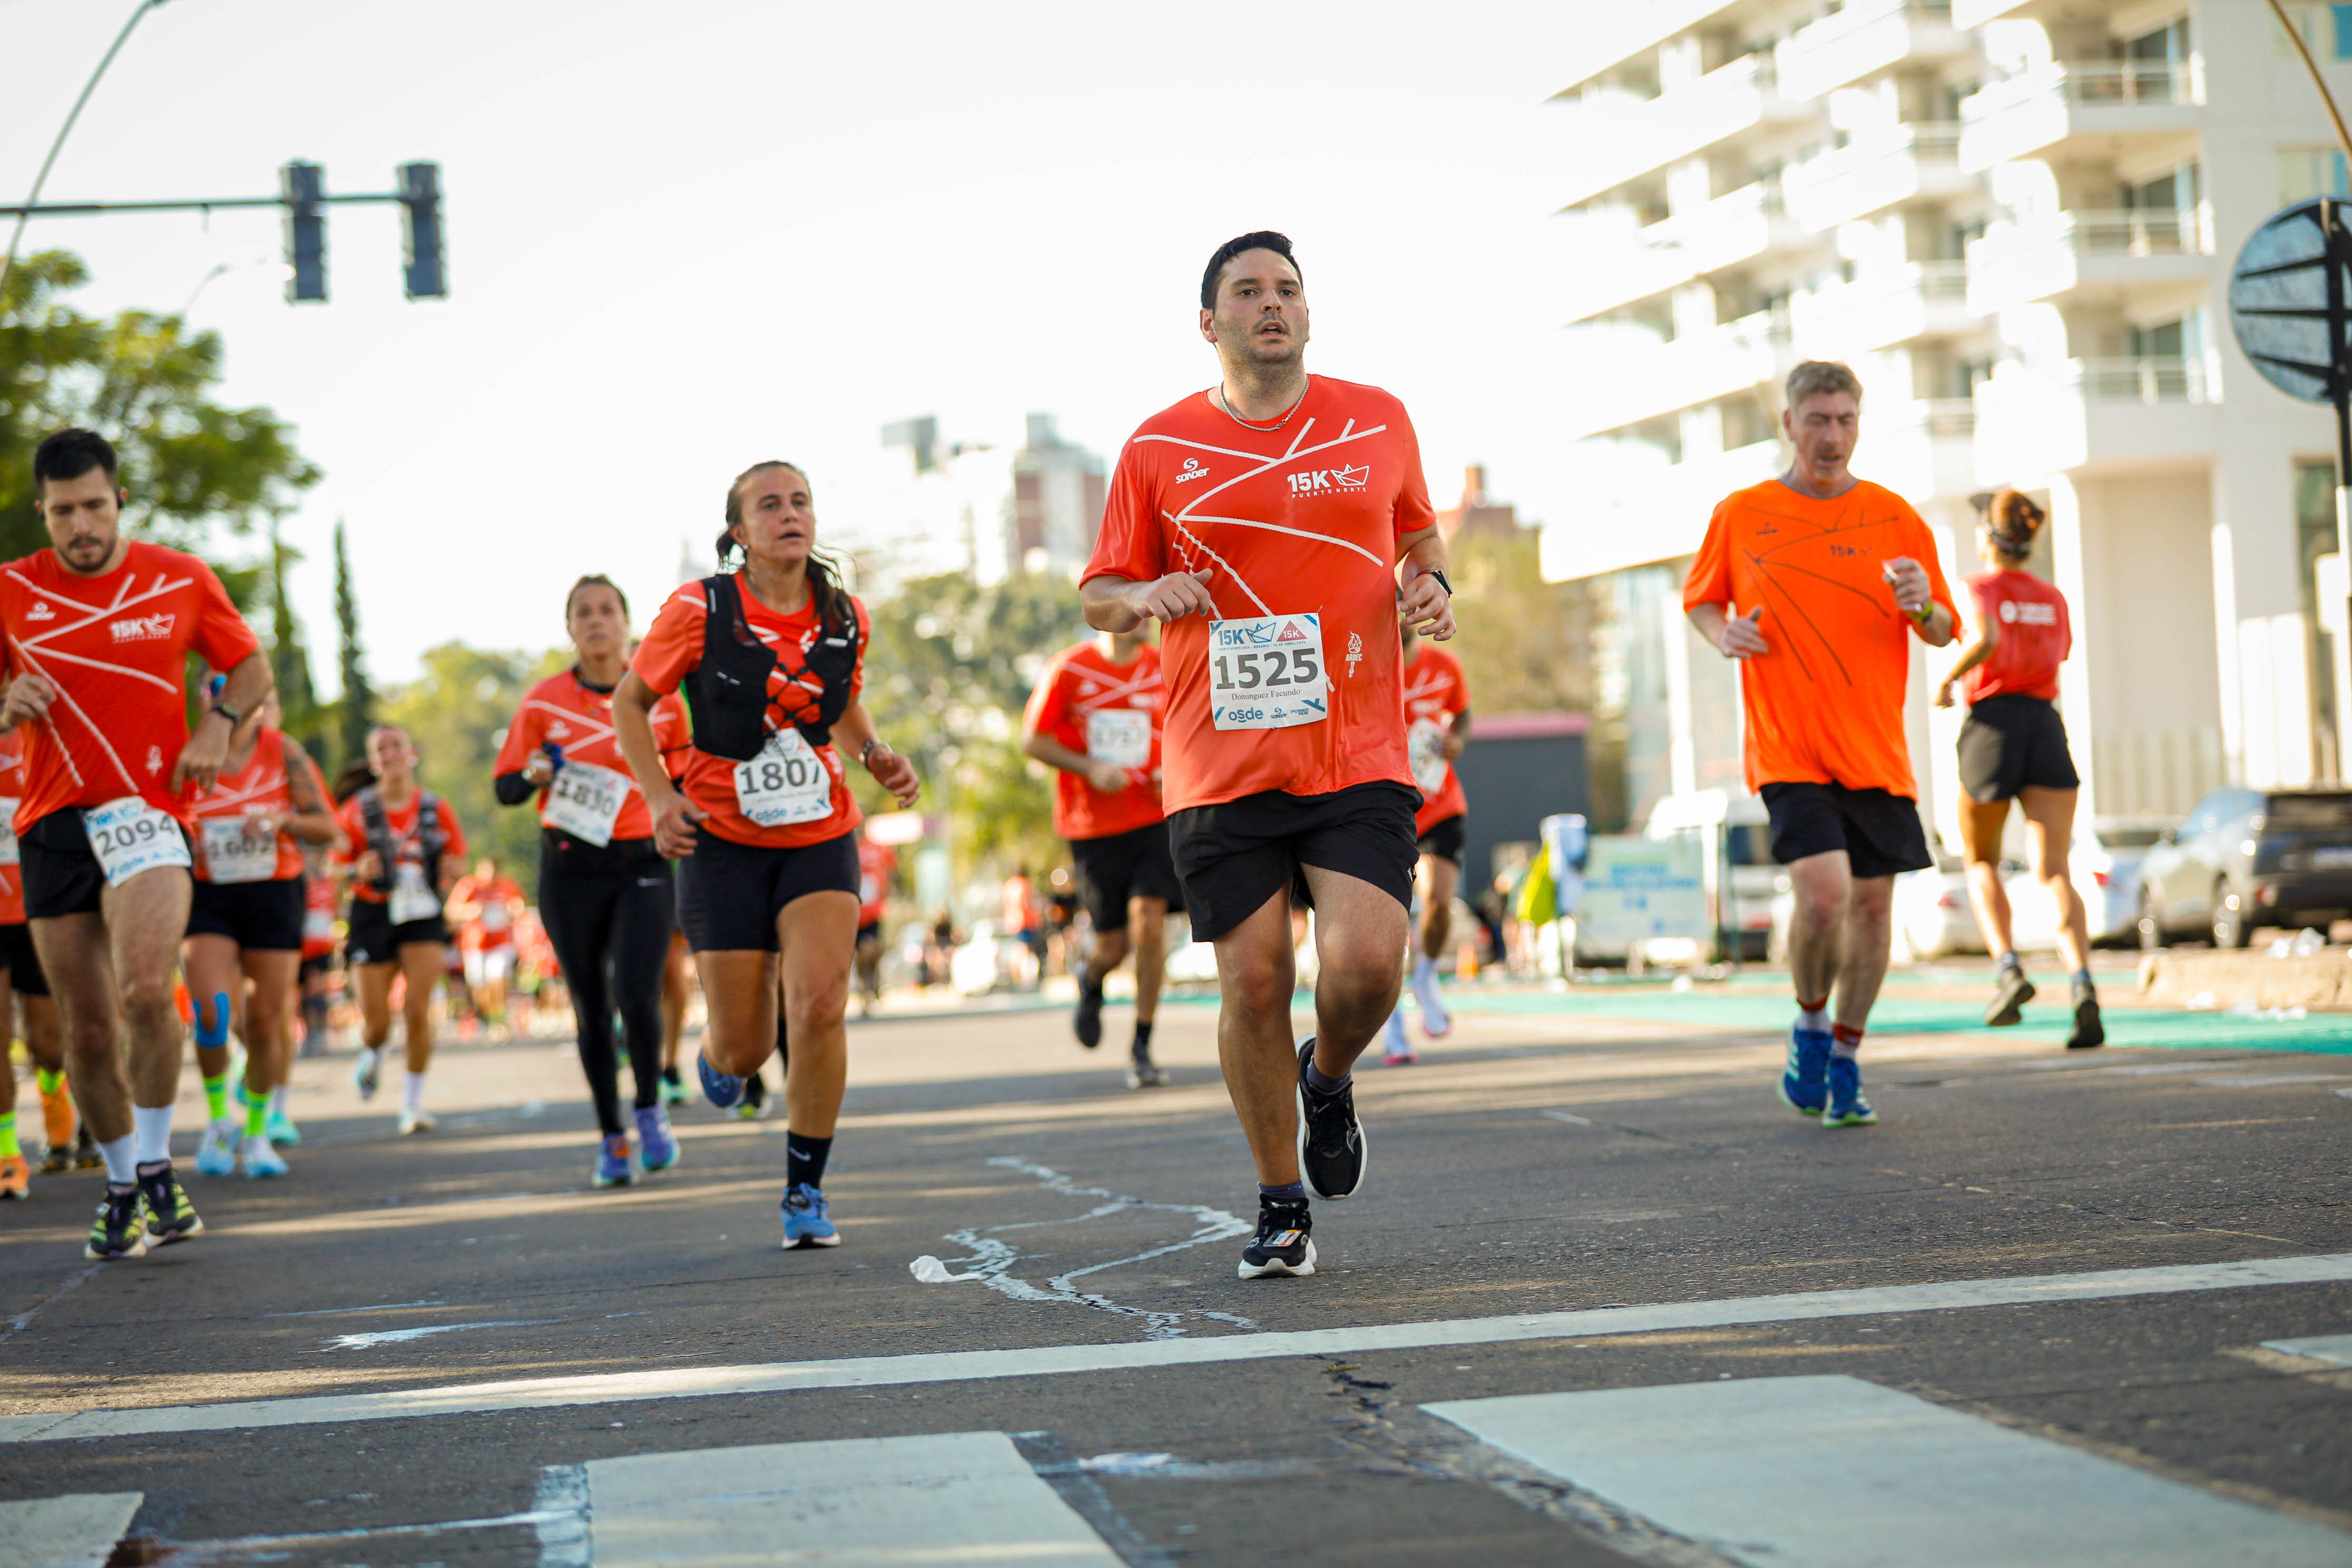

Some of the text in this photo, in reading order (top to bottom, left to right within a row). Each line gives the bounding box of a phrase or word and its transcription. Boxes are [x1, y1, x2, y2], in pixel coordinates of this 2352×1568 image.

[1287, 470, 1331, 492] 15K
[1292, 489, 1332, 498] PUERTO
[109, 618, 144, 639] 15K
[1282, 630, 1300, 639] 15K
[1218, 629, 1244, 645] 15K
[1345, 653, 1363, 662] ARDEC
[1214, 648, 1318, 689] 1525
[1232, 689, 1301, 701] Dominguez Facundo
[1228, 707, 1263, 722] osde
[740, 758, 819, 795] 1807
[96, 816, 175, 856] 2094
